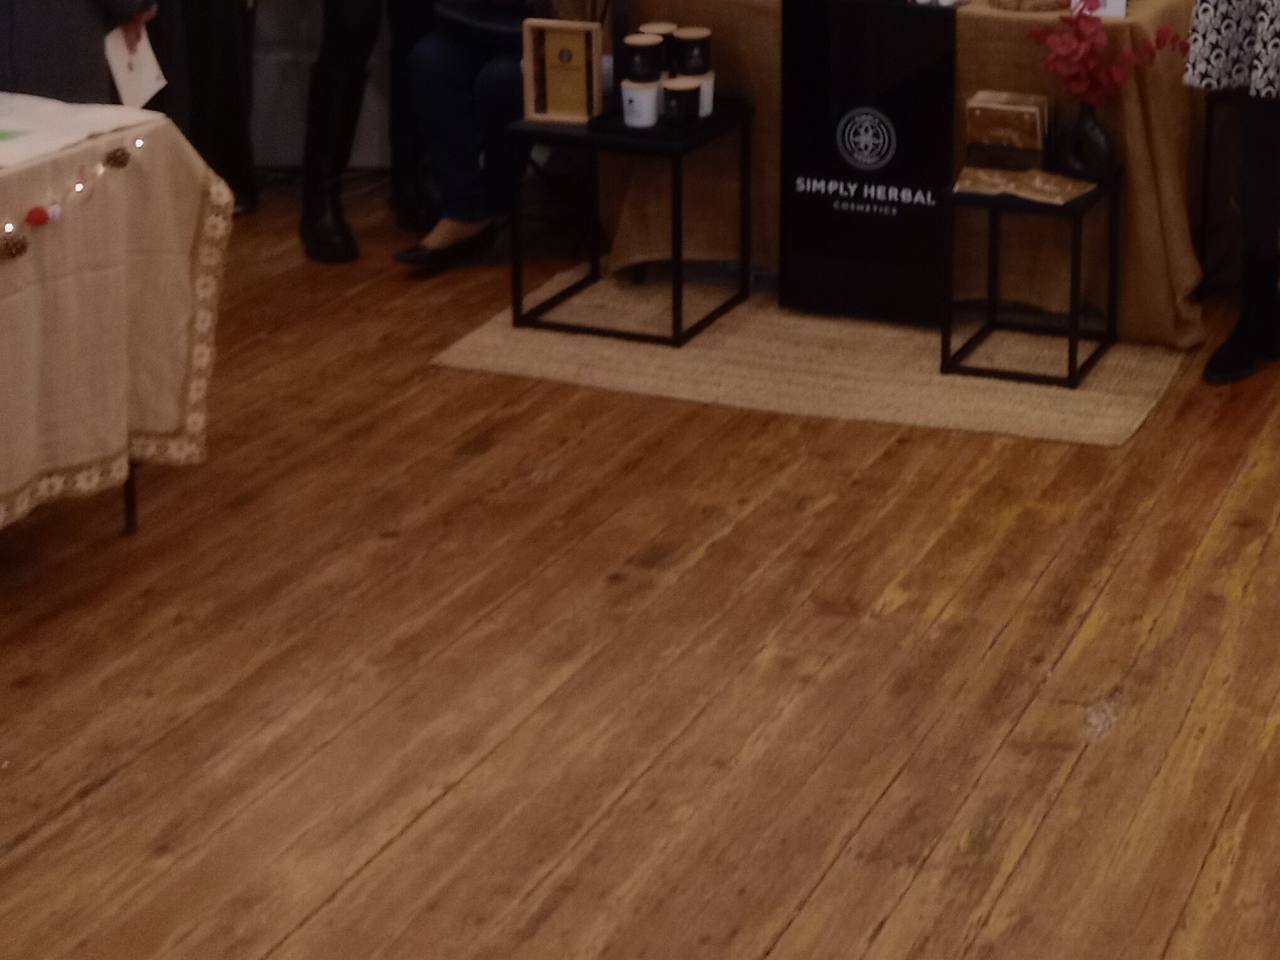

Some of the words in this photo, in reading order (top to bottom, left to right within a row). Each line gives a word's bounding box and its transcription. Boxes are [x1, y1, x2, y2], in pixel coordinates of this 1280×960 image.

[796, 177, 858, 197] SIMPLY
[864, 184, 936, 206] HERBAL
[833, 200, 897, 216] COSMETICS
